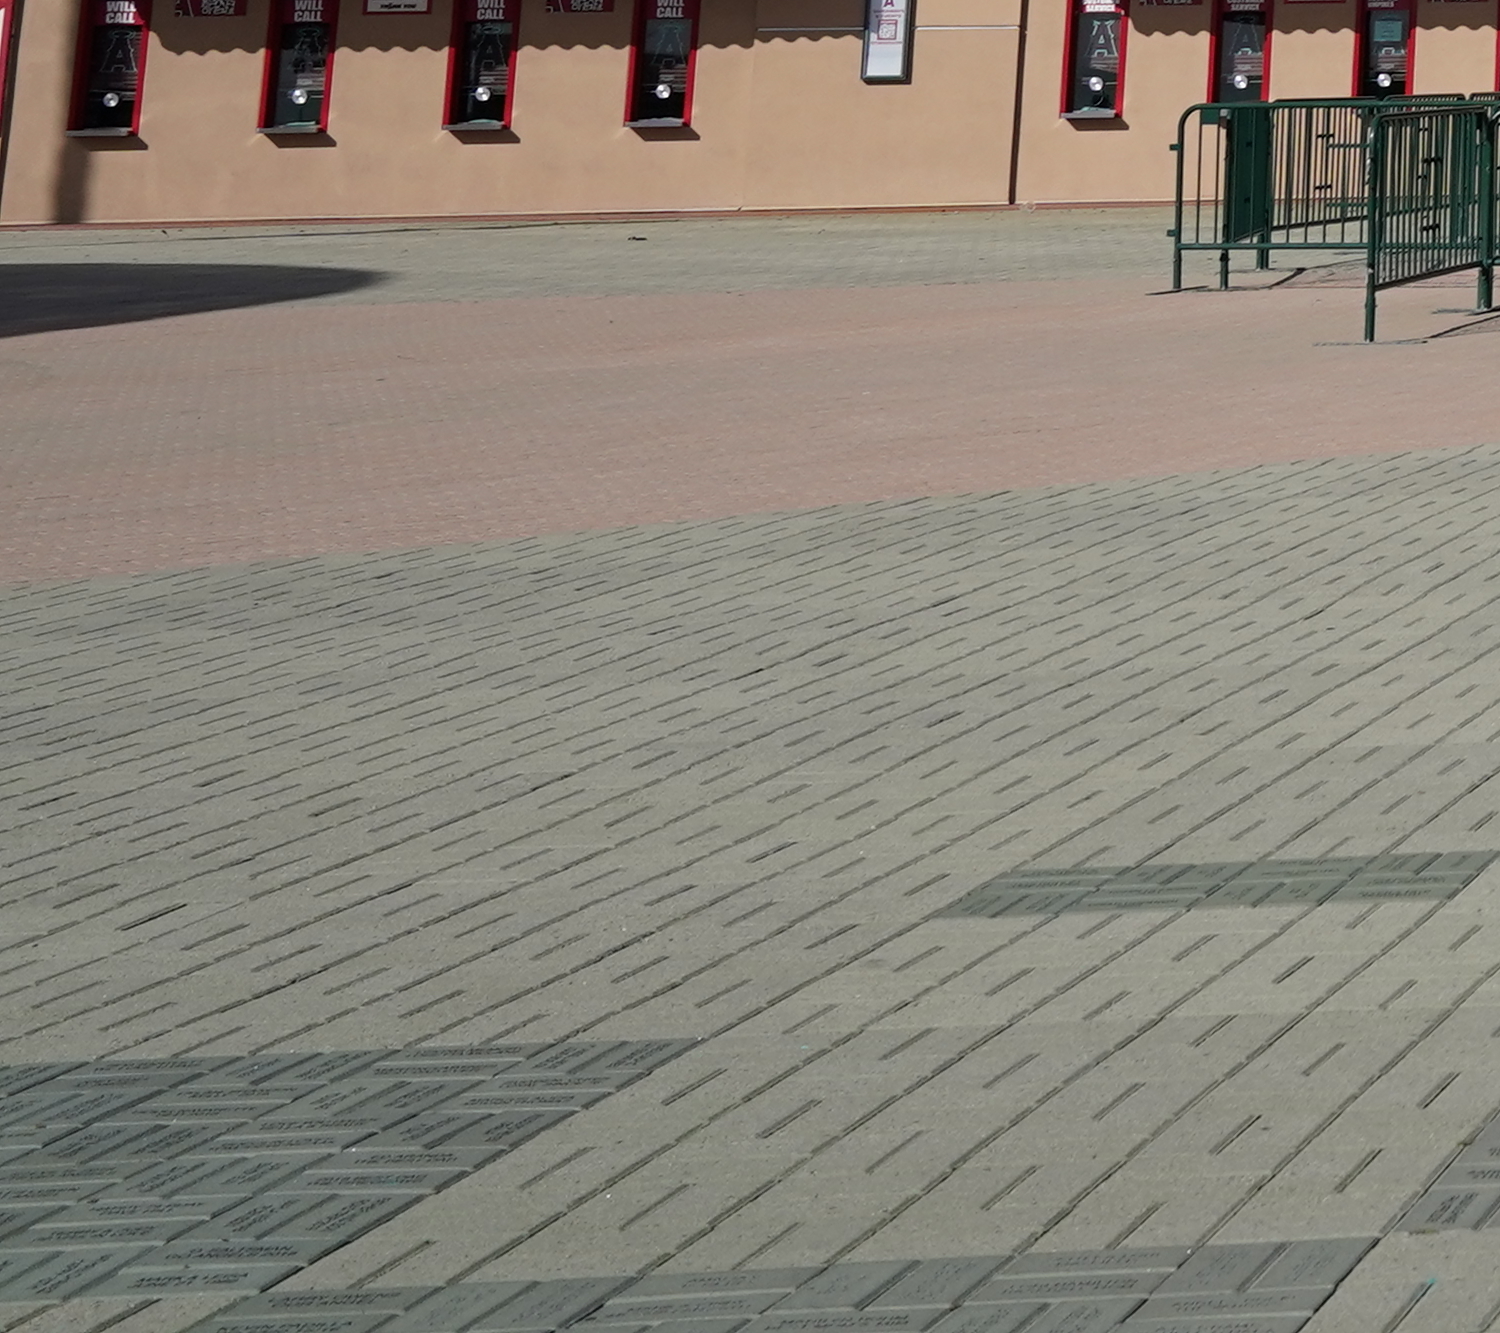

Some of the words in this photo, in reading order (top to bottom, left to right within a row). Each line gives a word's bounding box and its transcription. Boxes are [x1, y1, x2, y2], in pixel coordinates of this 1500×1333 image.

[106, 0, 137, 12] WILL
[294, 0, 323, 11] WILL
[105, 12, 136, 24] CALL
[294, 10, 322, 22] CALL
[476, 8, 505, 20] CALL
[655, 6, 684, 18] CALL
